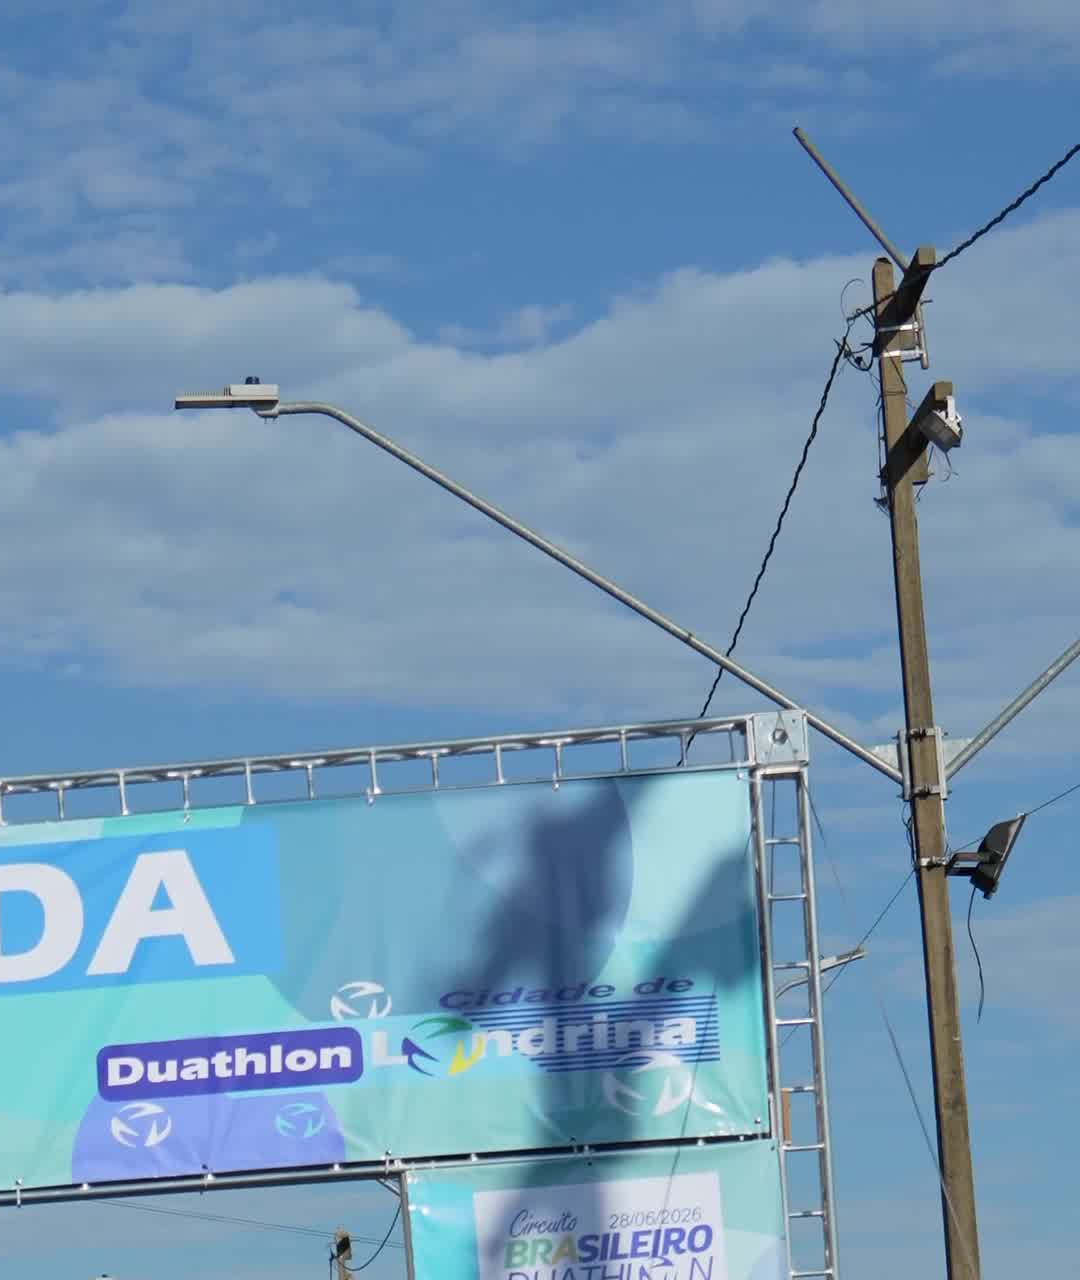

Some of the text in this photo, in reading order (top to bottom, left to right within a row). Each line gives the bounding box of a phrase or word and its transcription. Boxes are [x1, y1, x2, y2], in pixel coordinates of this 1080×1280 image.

[439, 976, 695, 1011] Cidade de
[107, 1040, 352, 1087] Duathlon
[510, 1207, 702, 1238] Circuito 28/06/2026
[504, 1224, 714, 1268] BRASILEIRO
